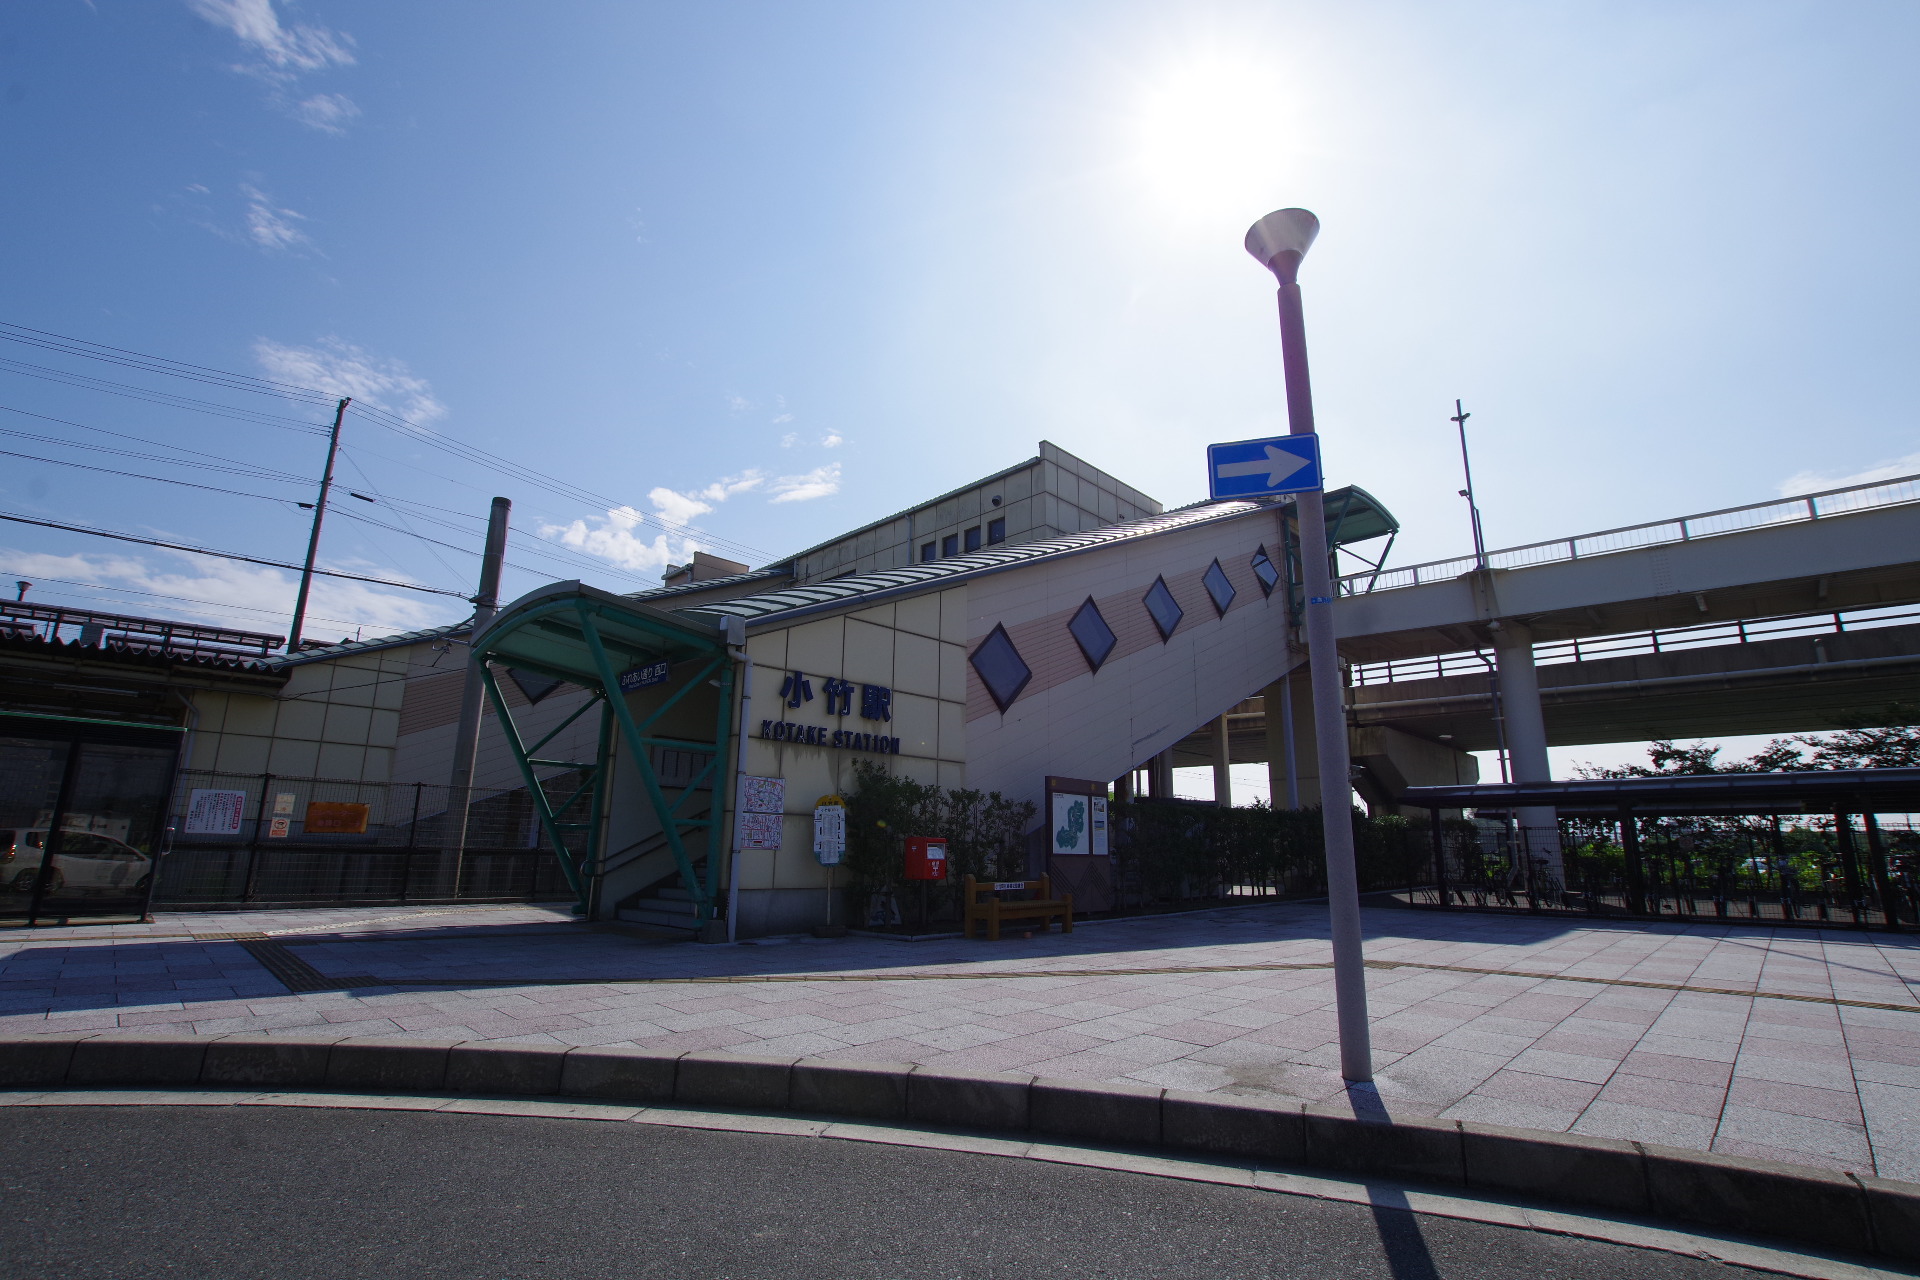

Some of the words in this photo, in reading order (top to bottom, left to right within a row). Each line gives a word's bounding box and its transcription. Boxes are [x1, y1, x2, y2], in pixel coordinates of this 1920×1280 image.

[621, 667, 653, 686] ふれあい通り
[654, 662, 667, 677] 西口
[779, 671, 892, 723] 小竹駅
[761, 719, 828, 747] KOTAKE
[832, 729, 900, 754] STATION
